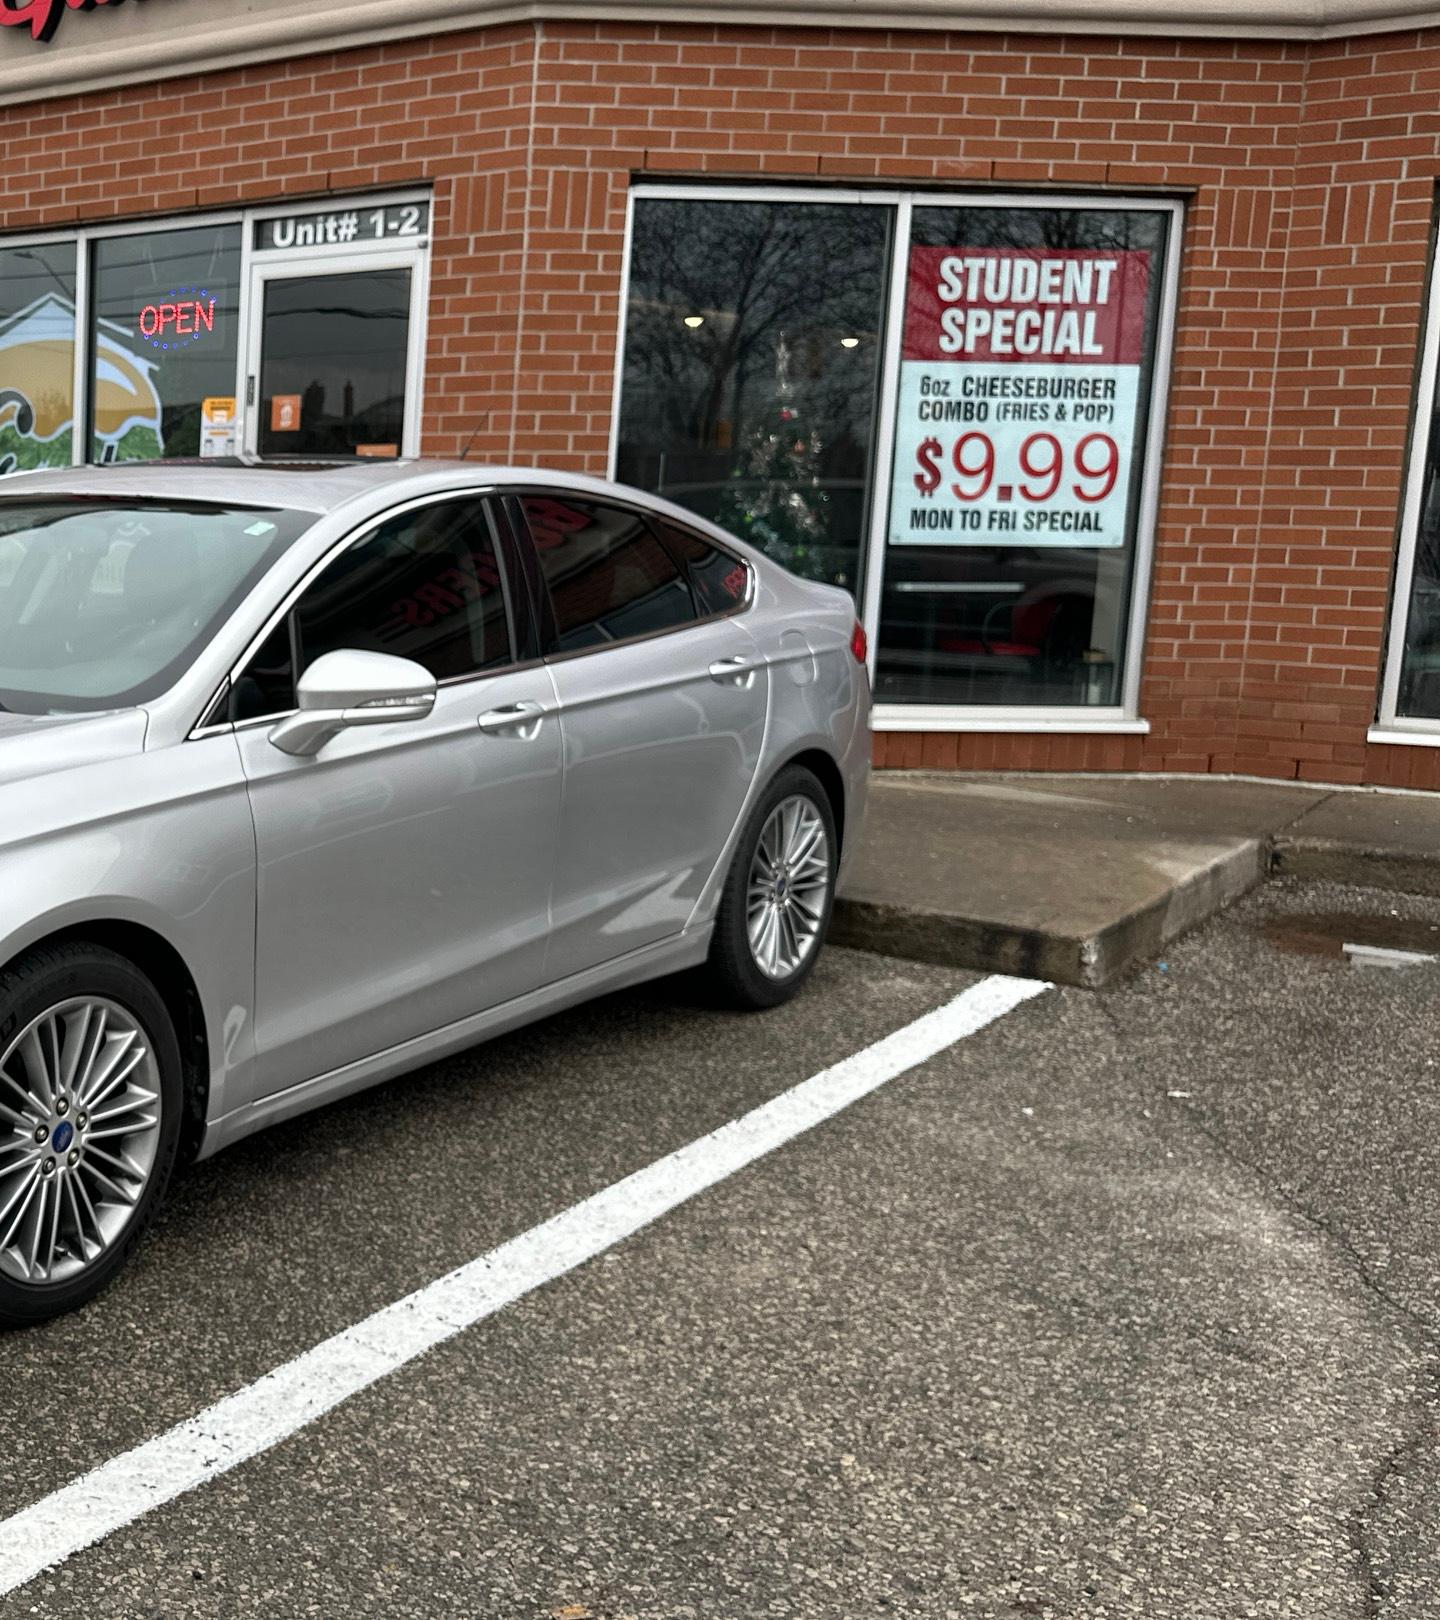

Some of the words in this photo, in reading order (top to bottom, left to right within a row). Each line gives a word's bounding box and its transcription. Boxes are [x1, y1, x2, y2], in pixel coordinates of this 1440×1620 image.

[272, 211, 359, 248] Unit#
[369, 206, 421, 238] 1-2
[936, 256, 1118, 305] STUDENT
[139, 301, 216, 336] OPEN
[938, 307, 1103, 356] SPECIAL
[920, 375, 950, 397] 6oz
[961, 376, 1117, 400] CHEESEBURGER
[918, 401, 989, 423] COMBO
[996, 402, 1049, 423] (FRIES
[1055, 402, 1066, 423] &
[1072, 403, 1115, 424] POP)
[913, 431, 1120, 504] $9.99
[910, 510, 954, 531] MON
[959, 510, 981, 531] TO
[987, 510, 1017, 531] FRI
[1023, 511, 1103, 533] SPECIAL
